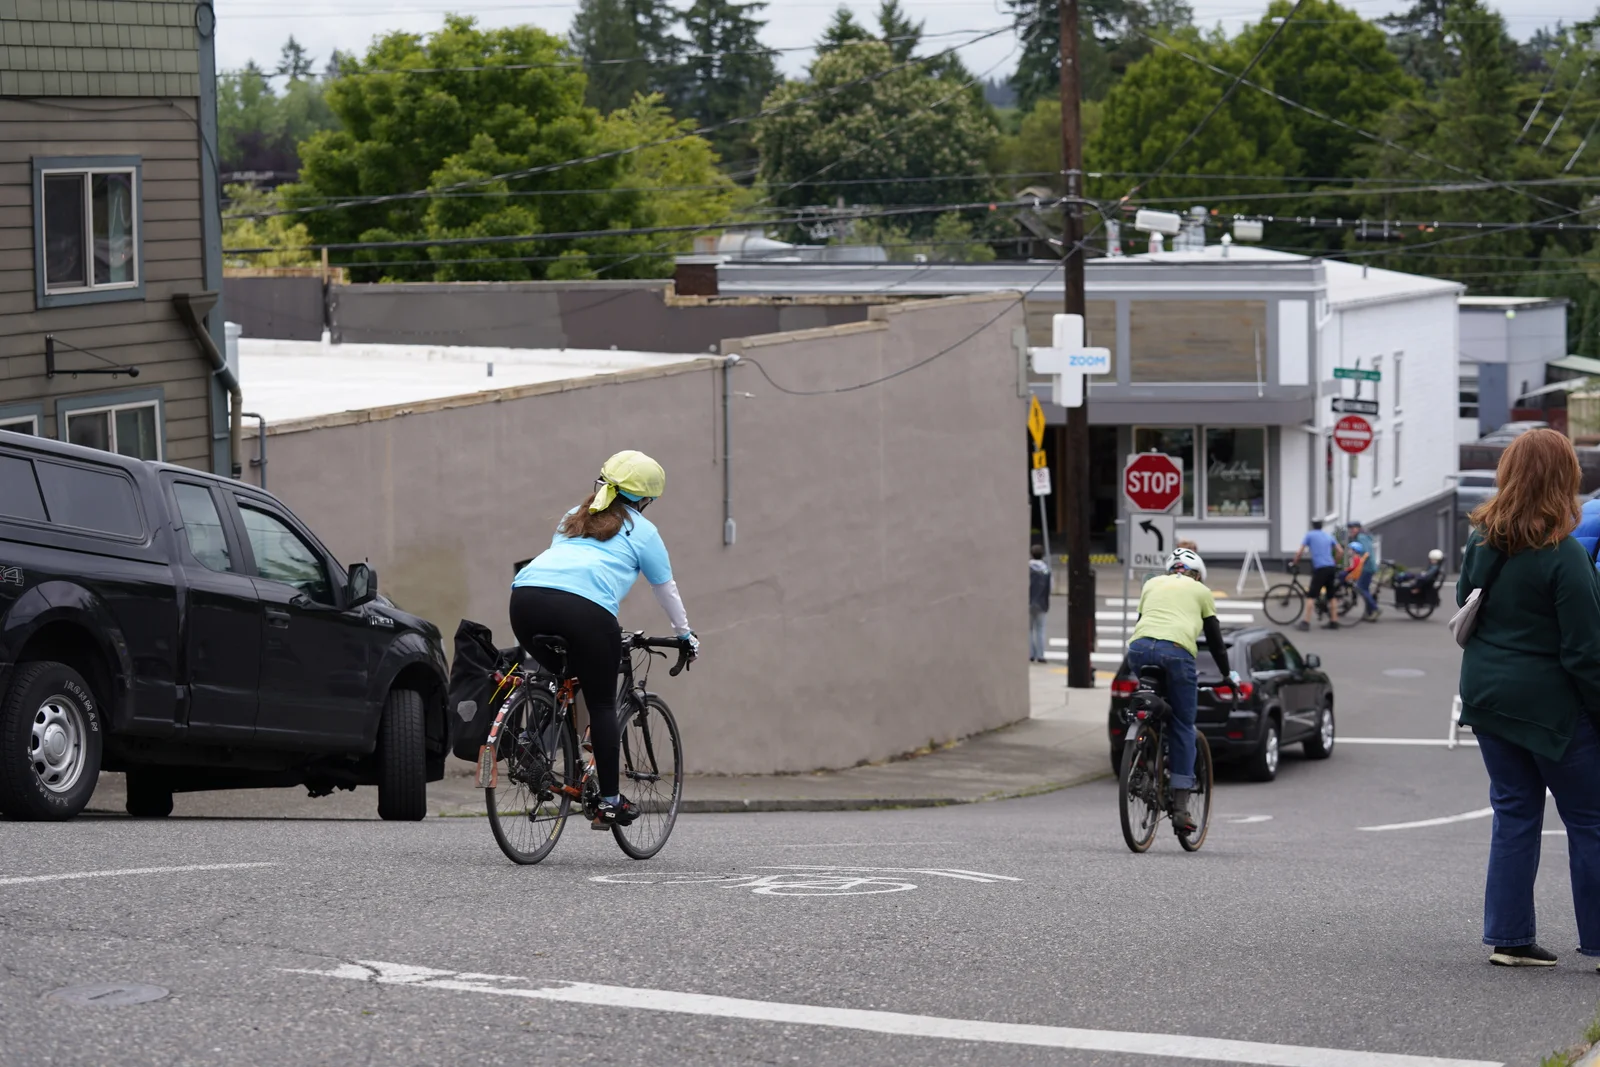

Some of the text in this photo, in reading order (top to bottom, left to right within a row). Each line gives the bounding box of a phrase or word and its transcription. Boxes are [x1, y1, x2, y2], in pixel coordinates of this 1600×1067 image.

[1069, 355, 1106, 366] ZOOM
[1128, 471, 1179, 494] STOP
[1134, 554, 1168, 566] ONLY
[64, 680, 98, 732] IRONMAN
